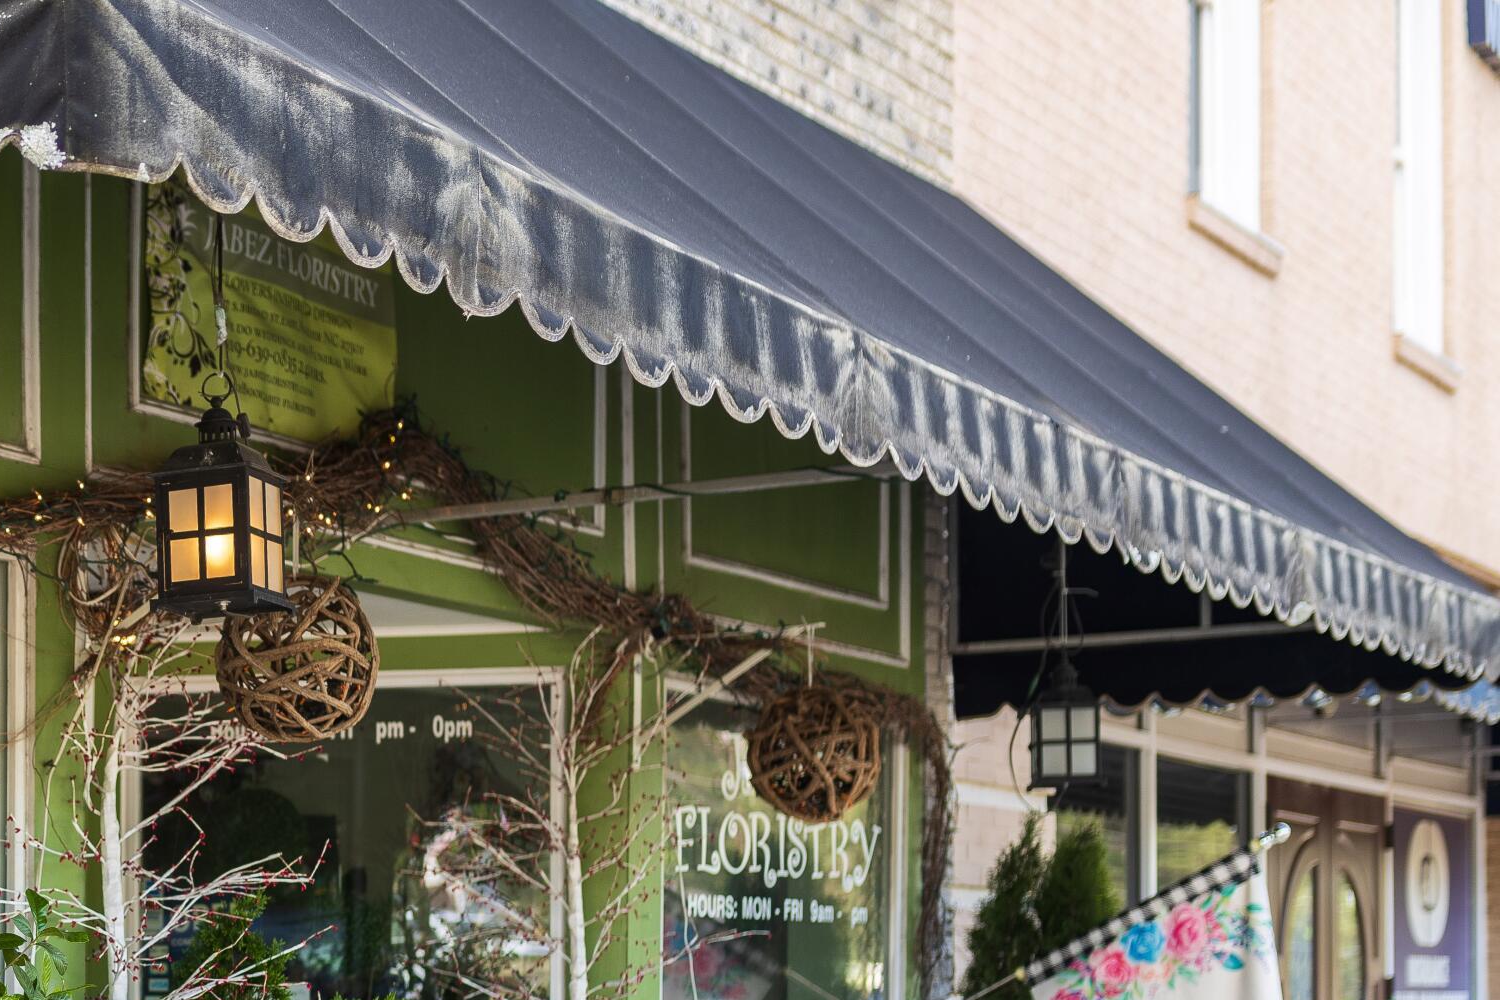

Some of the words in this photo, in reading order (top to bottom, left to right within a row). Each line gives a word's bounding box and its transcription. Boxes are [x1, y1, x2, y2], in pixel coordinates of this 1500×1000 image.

[203, 215, 273, 266] JABEZ
[276, 241, 379, 309] FLORISTRY
[226, 338, 298, 374] 19-639-0835
[376, 721, 404, 744] pm
[432, 714, 473, 744] 0pm
[675, 805, 882, 892] FLORISTRY
[687, 894, 738, 919] HOURS:
[742, 895, 771, 920] MON
[783, 898, 803, 922] FRI
[809, 899, 834, 923] 9am
[851, 906, 868, 929] pm
